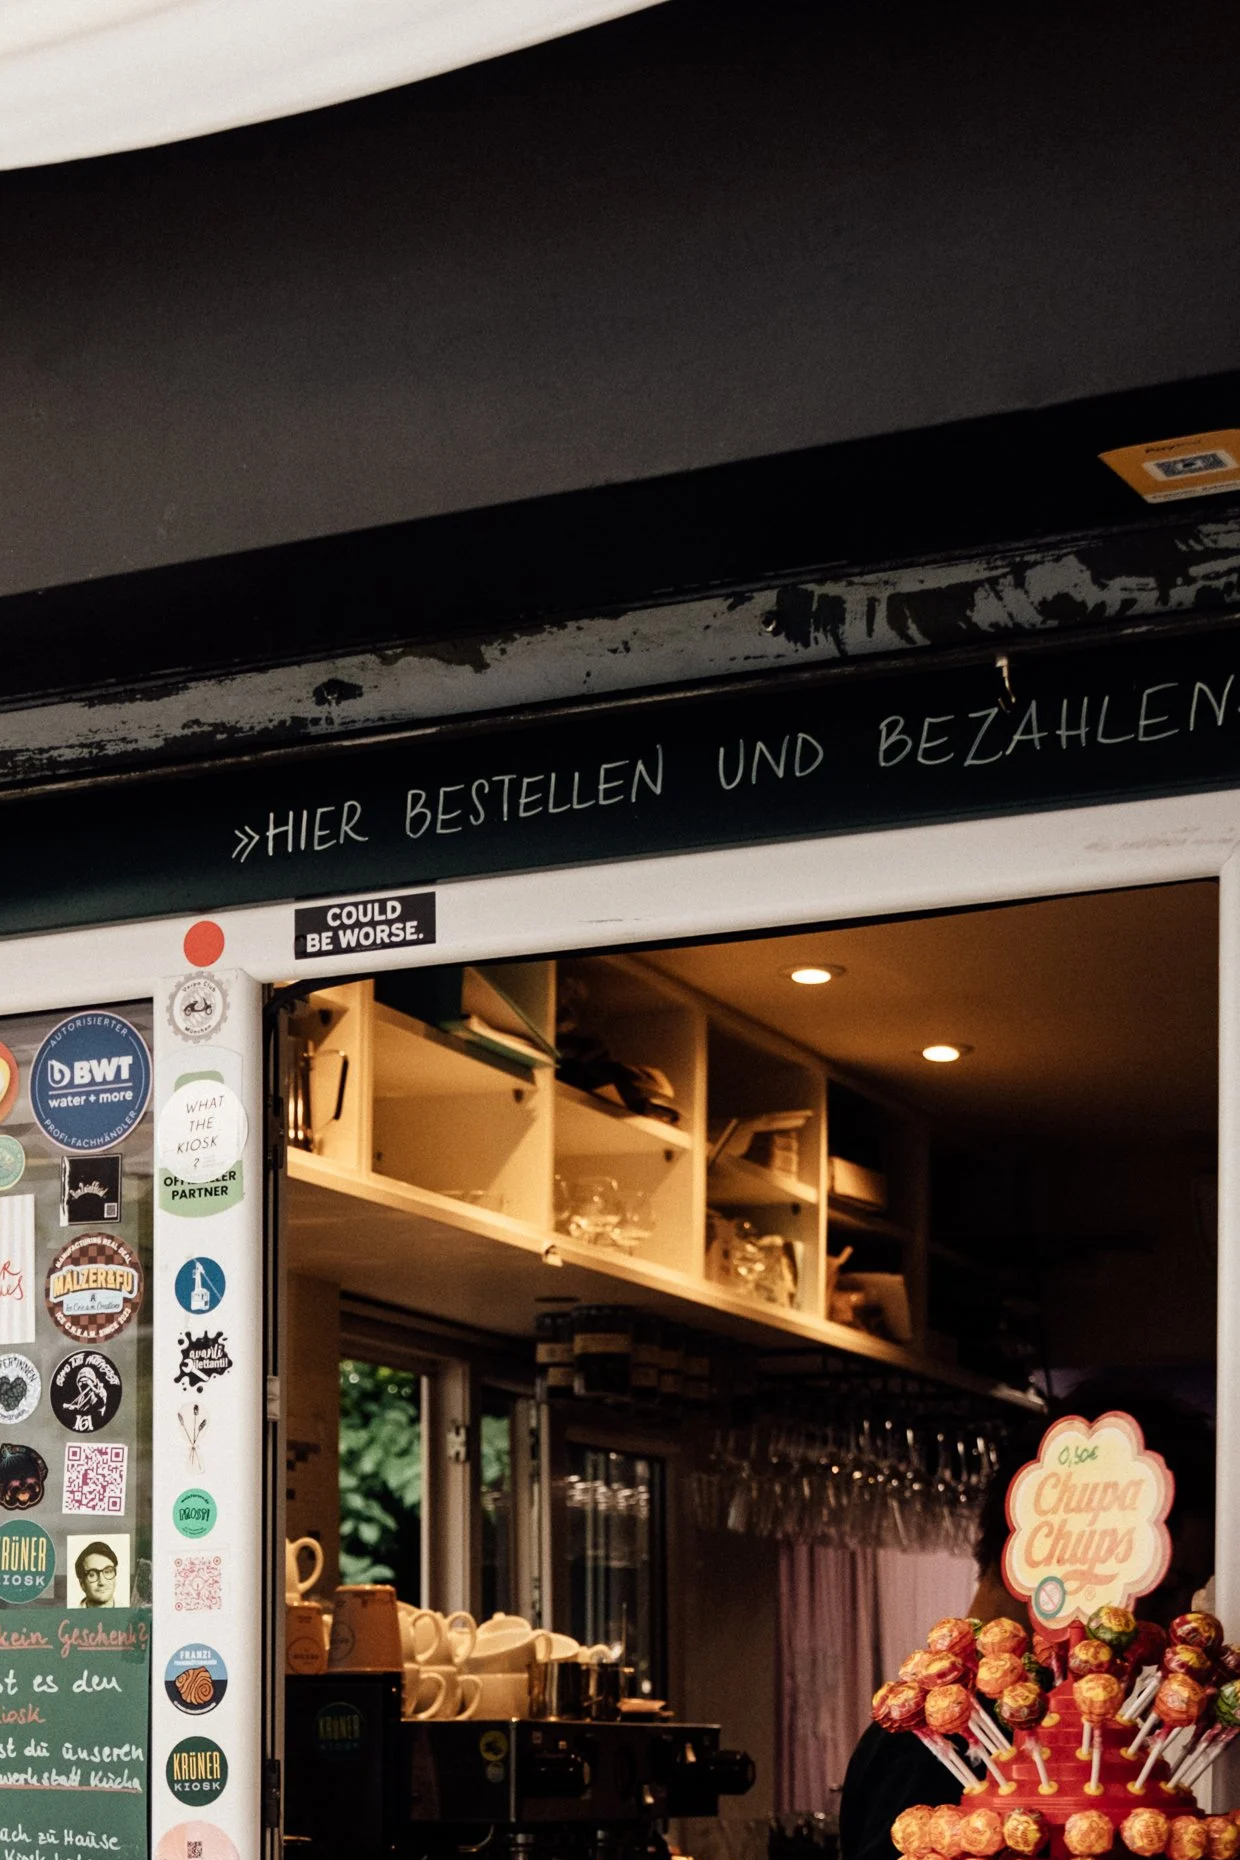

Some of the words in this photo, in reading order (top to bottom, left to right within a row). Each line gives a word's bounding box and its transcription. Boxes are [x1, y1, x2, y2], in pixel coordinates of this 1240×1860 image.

[266, 800, 369, 856] HIER
[405, 744, 664, 839] BESTELLEN
[718, 732, 824, 790] UND
[878, 673, 1236, 768] BEZAHLEN
[327, 901, 402, 928] COULD
[306, 934, 333, 952] BE
[339, 921, 425, 950] WORSE.
[50, 1017, 128, 1048] AUTORISIERTER
[73, 1055, 133, 1085] BWT
[48, 1095, 87, 1108] water
[99, 1090, 133, 1103] more
[186, 1096, 226, 1114] WHAT
[190, 1116, 214, 1132] THE
[176, 1135, 219, 1155] KIOSK
[171, 1187, 229, 1200] PARTNER
[72, 1414, 94, 1432] 161
[1034, 1471, 1146, 1528] Chupa
[1024, 1519, 1137, 1578] Chups
[180, 1650, 211, 1660] FRANZI
[32, 1674, 60, 1693] es
[173, 1751, 221, 1781] KRÜNER
[174, 1781, 221, 1791] KIOSK
